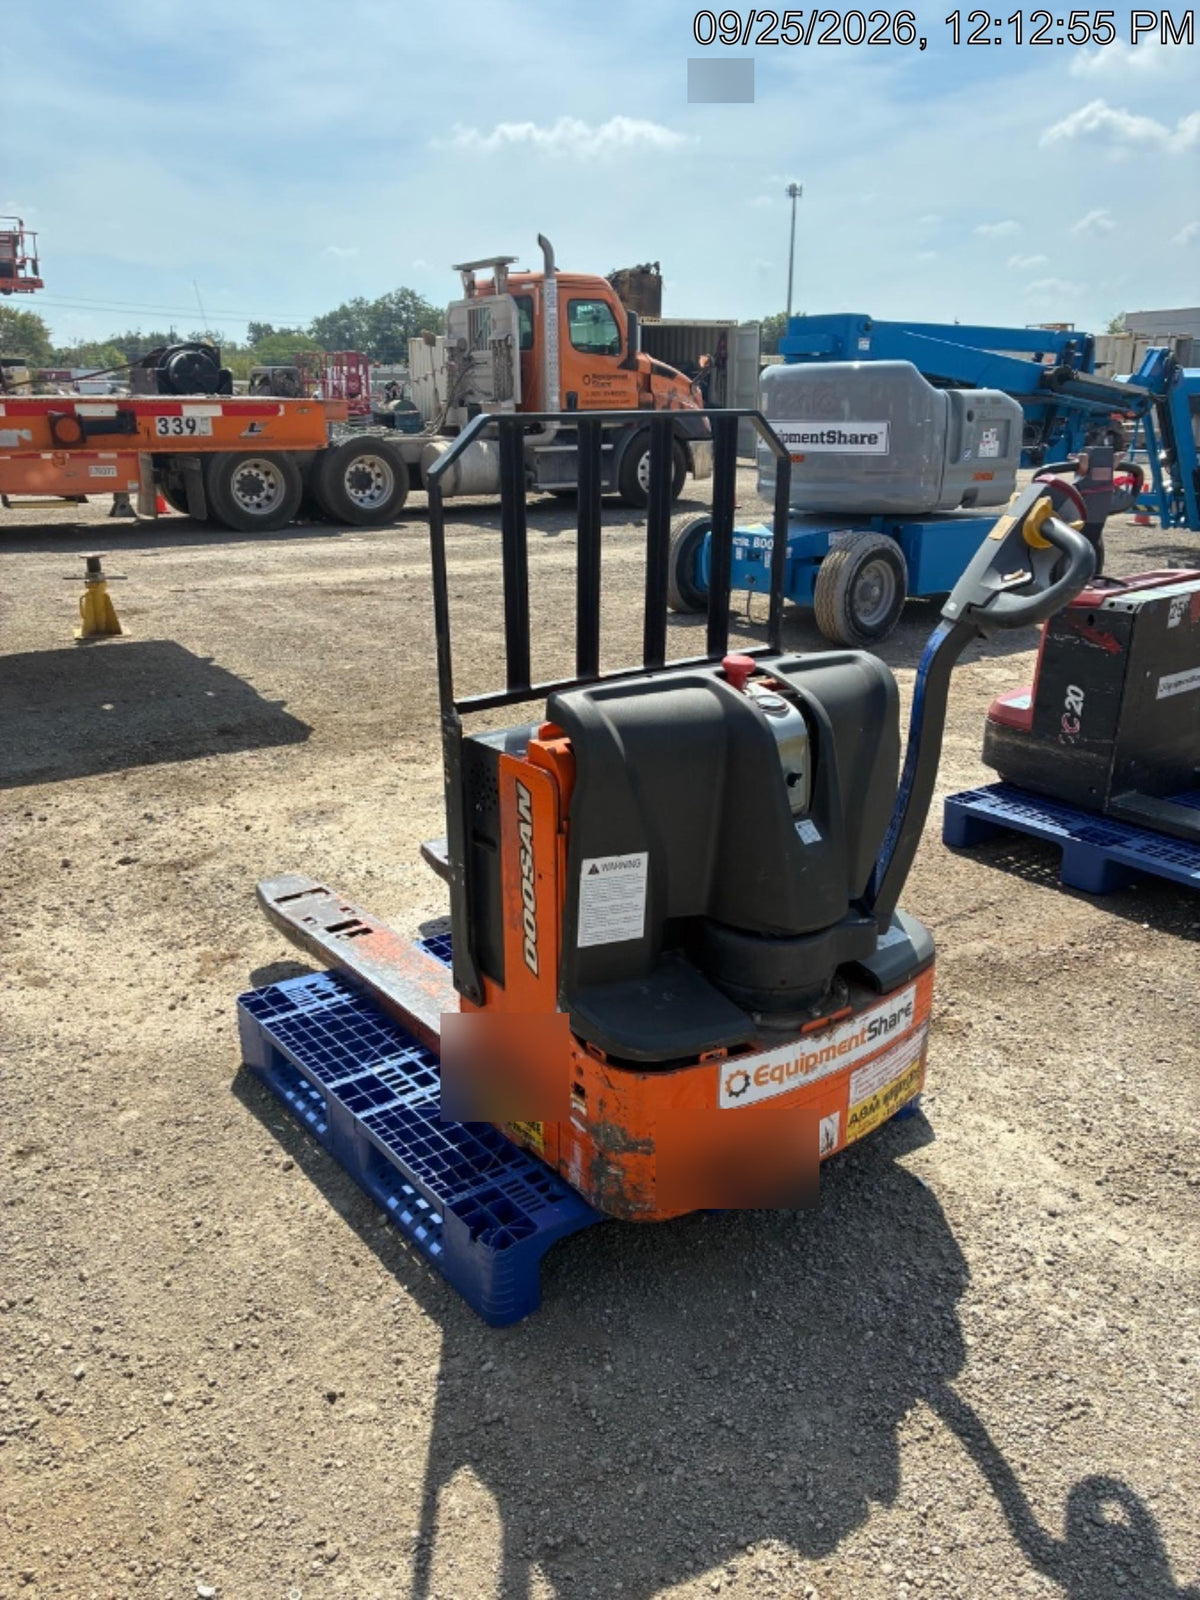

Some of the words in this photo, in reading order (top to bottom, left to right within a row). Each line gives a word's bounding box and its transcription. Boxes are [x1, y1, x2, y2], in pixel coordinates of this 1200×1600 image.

[157, 417, 196, 435] 339
[515, 777, 539, 980] DOOSAN
[600, 858, 641, 872] WARNING
[753, 1000, 913, 1086] EquipmentShare
